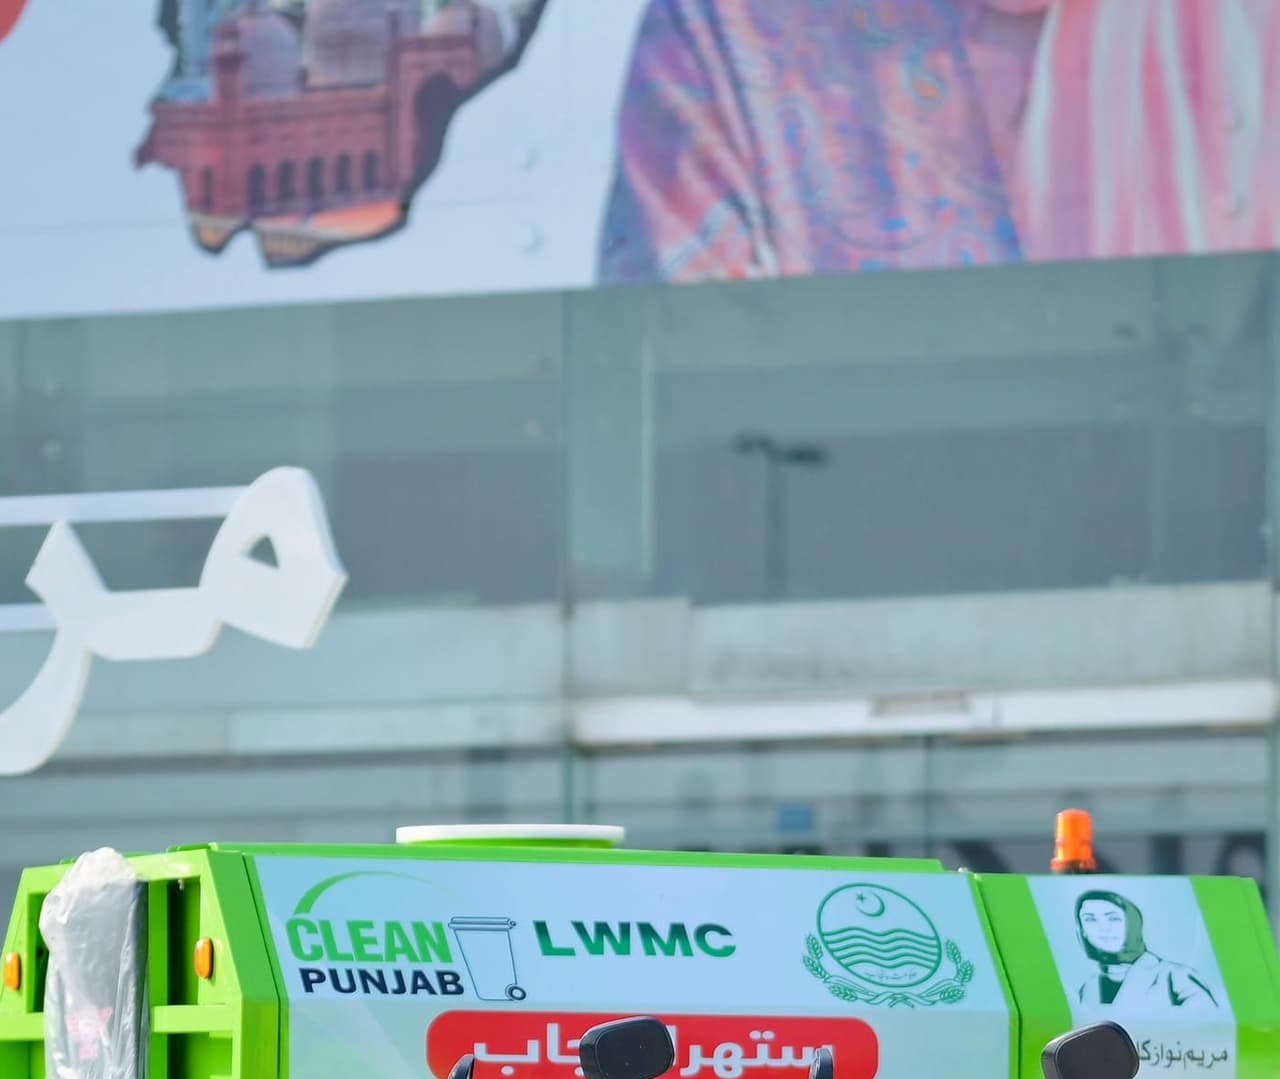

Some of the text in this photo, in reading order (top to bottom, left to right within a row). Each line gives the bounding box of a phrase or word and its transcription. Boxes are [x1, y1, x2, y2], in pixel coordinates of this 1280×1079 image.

[286, 916, 453, 963] CLEAN
[534, 920, 736, 958] LWMC
[299, 967, 465, 996] PUNJAB
[1151, 1040, 1182, 1069] نواز
[1183, 1048, 1228, 1071] مریم
